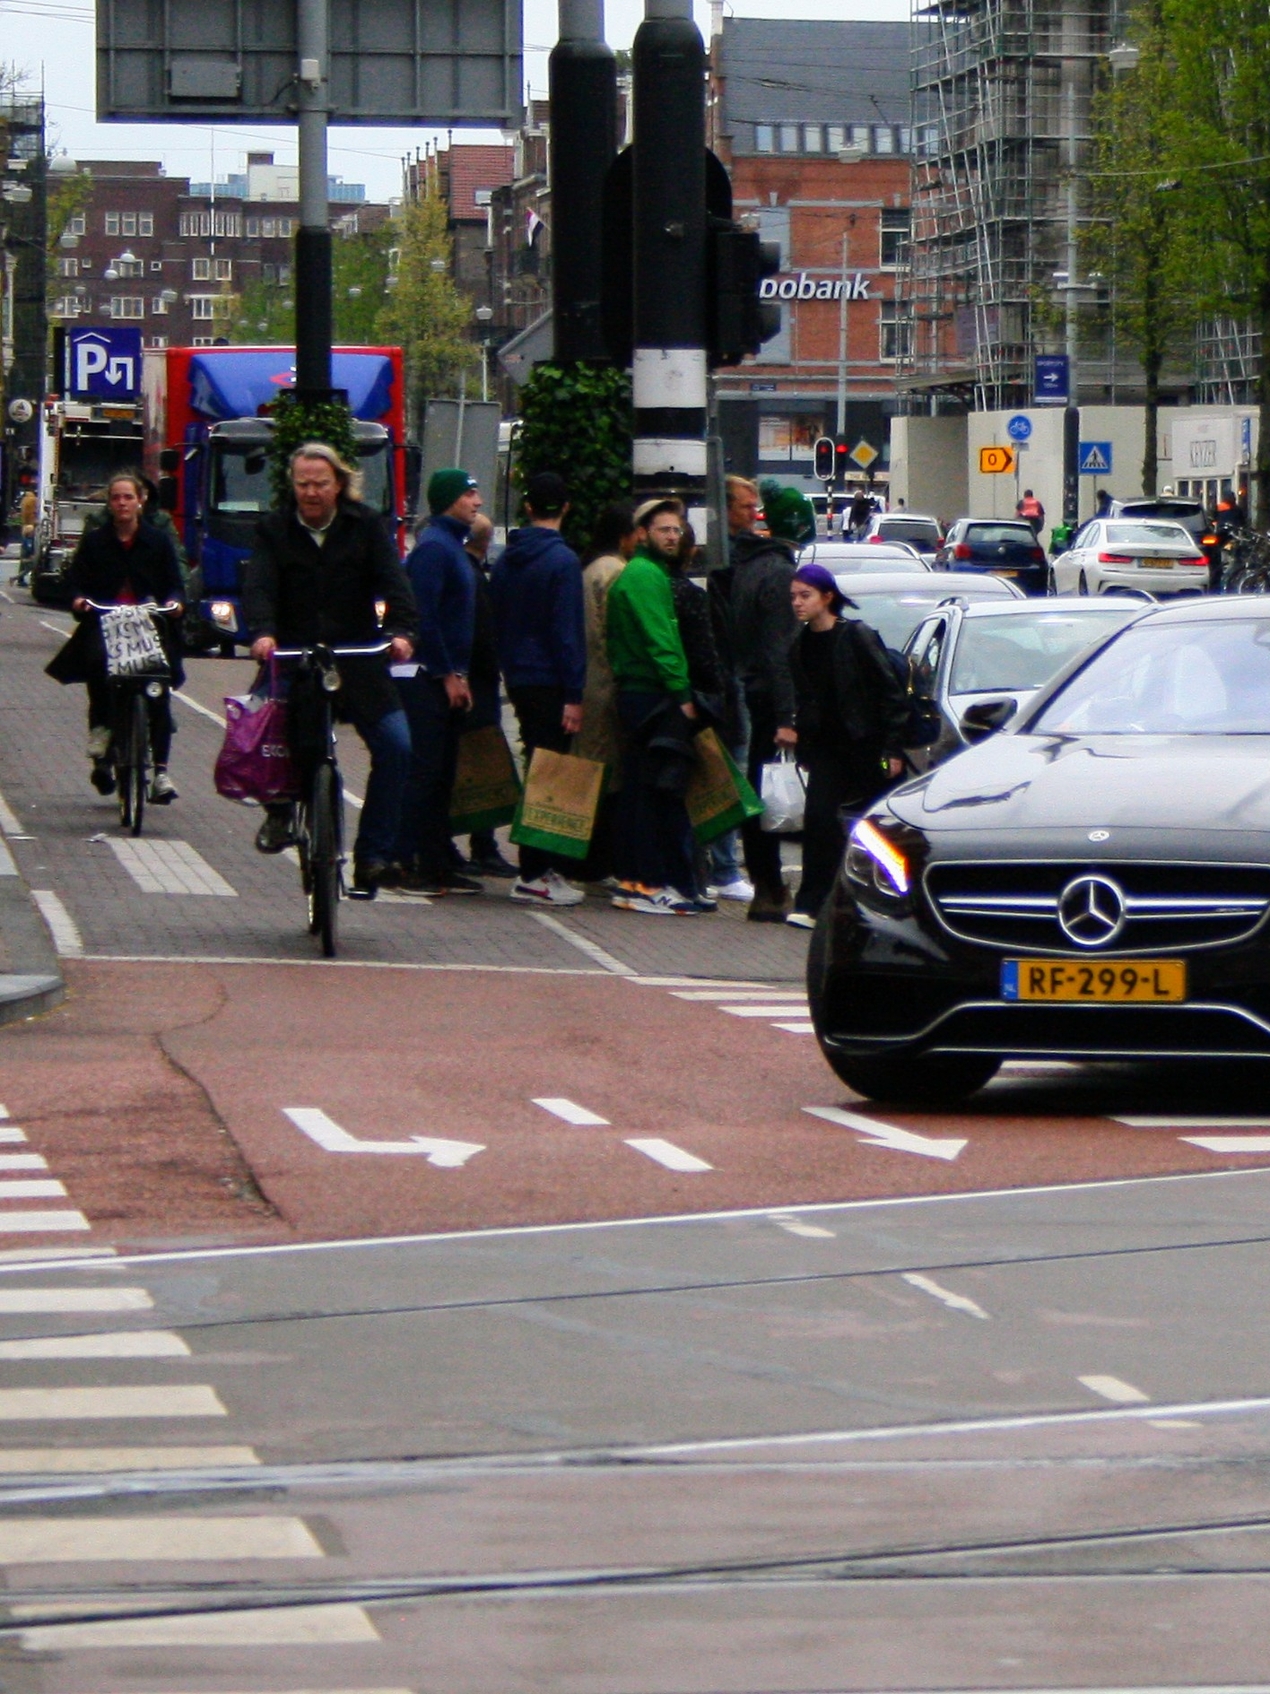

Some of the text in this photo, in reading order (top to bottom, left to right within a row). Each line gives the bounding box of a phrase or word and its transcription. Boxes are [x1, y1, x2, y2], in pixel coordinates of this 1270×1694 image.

[77, 343, 108, 391] P
[1190, 440, 1216, 467] KEYZER
[1028, 966, 1170, 996] RF-299-L
